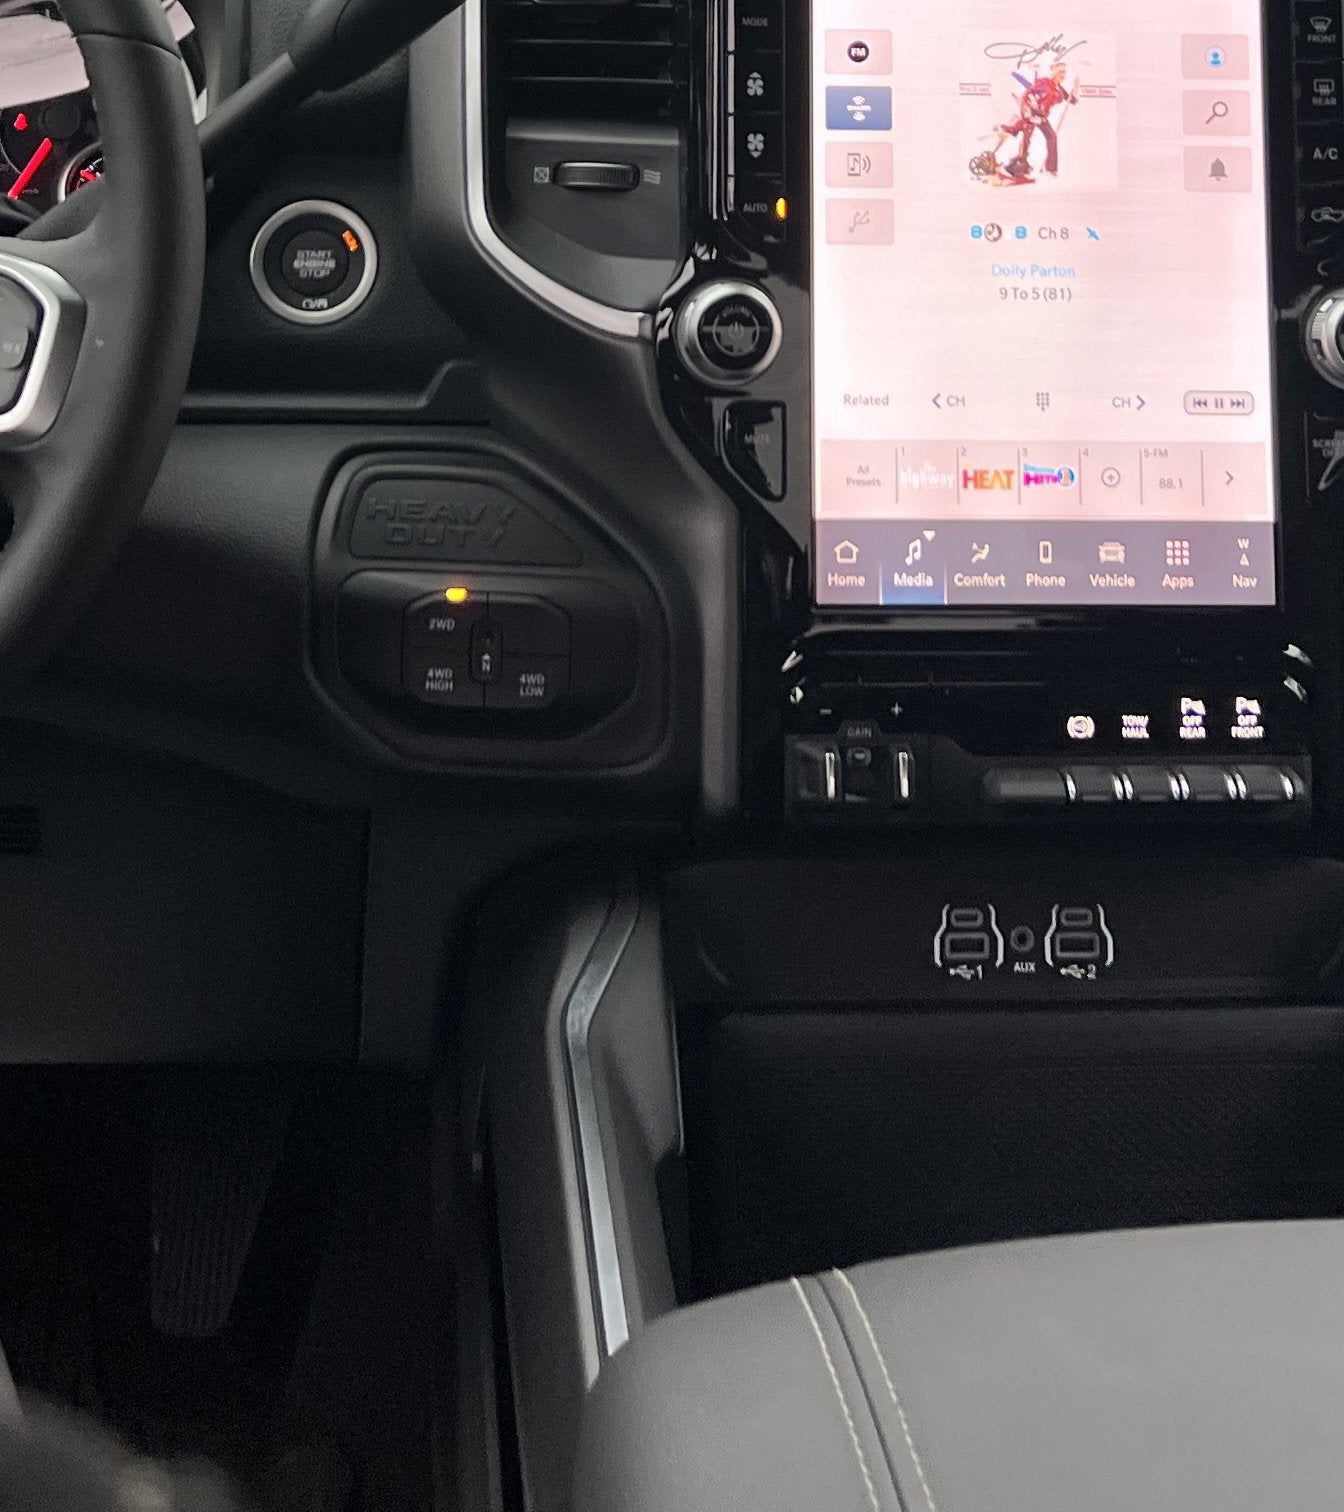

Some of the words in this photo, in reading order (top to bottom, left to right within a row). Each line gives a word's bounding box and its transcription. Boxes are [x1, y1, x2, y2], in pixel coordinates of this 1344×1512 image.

[742, 17, 768, 27] MODE
[1307, 34, 1337, 45] FRONT
[851, 47, 866, 57] FM
[1312, 96, 1337, 107] REAR
[1312, 148, 1338, 160] A/C
[743, 203, 768, 213] AUTO
[1038, 227, 1056, 240] Ch
[1060, 227, 1070, 239] 8
[297, 250, 332, 258] START
[299, 269, 330, 278] STOP
[991, 264, 1027, 279] Dolly
[1030, 264, 1076, 277] Parton
[999, 287, 1008, 300] 9
[1011, 287, 1028, 300] To
[1032, 287, 1040, 300] 5
[1043, 287, 1073, 303] (81)
[843, 394, 890, 406] Related
[946, 395, 966, 407] CH
[1112, 397, 1131, 408] CH
[960, 448, 967, 456] 2
[1022, 448, 1028, 457] 3
[1082, 449, 1089, 457] 4
[857, 465, 870, 475] All
[846, 477, 881, 488] Presets
[962, 469, 1015, 489] HEAT
[1158, 478, 1183, 489] 88.1
[366, 498, 516, 525] HEAVY
[386, 522, 506, 549] DUTY
[827, 572, 866, 587] Home
[893, 572, 934, 587] Media
[953, 572, 1006, 587] Comfort
[1025, 573, 1066, 587] Phone
[1089, 574, 1136, 587] Vehicle
[1162, 574, 1194, 589] Apps
[1232, 574, 1257, 588] Nav
[429, 617, 455, 631] 2WD
[482, 660, 491, 672] N
[427, 668, 453, 679] 4WD
[425, 679, 454, 691] HIGH
[519, 674, 545, 686] 4WD
[520, 686, 544, 697] LOW
[1182, 715, 1203, 726] OFF
[1237, 715, 1258, 726] OFF
[847, 727, 872, 738] GAIN
[1179, 727, 1206, 738] REAR
[1231, 726, 1264, 738] FRONT
[1013, 961, 1036, 974] AUX
[1087, 964, 1097, 980] 2
